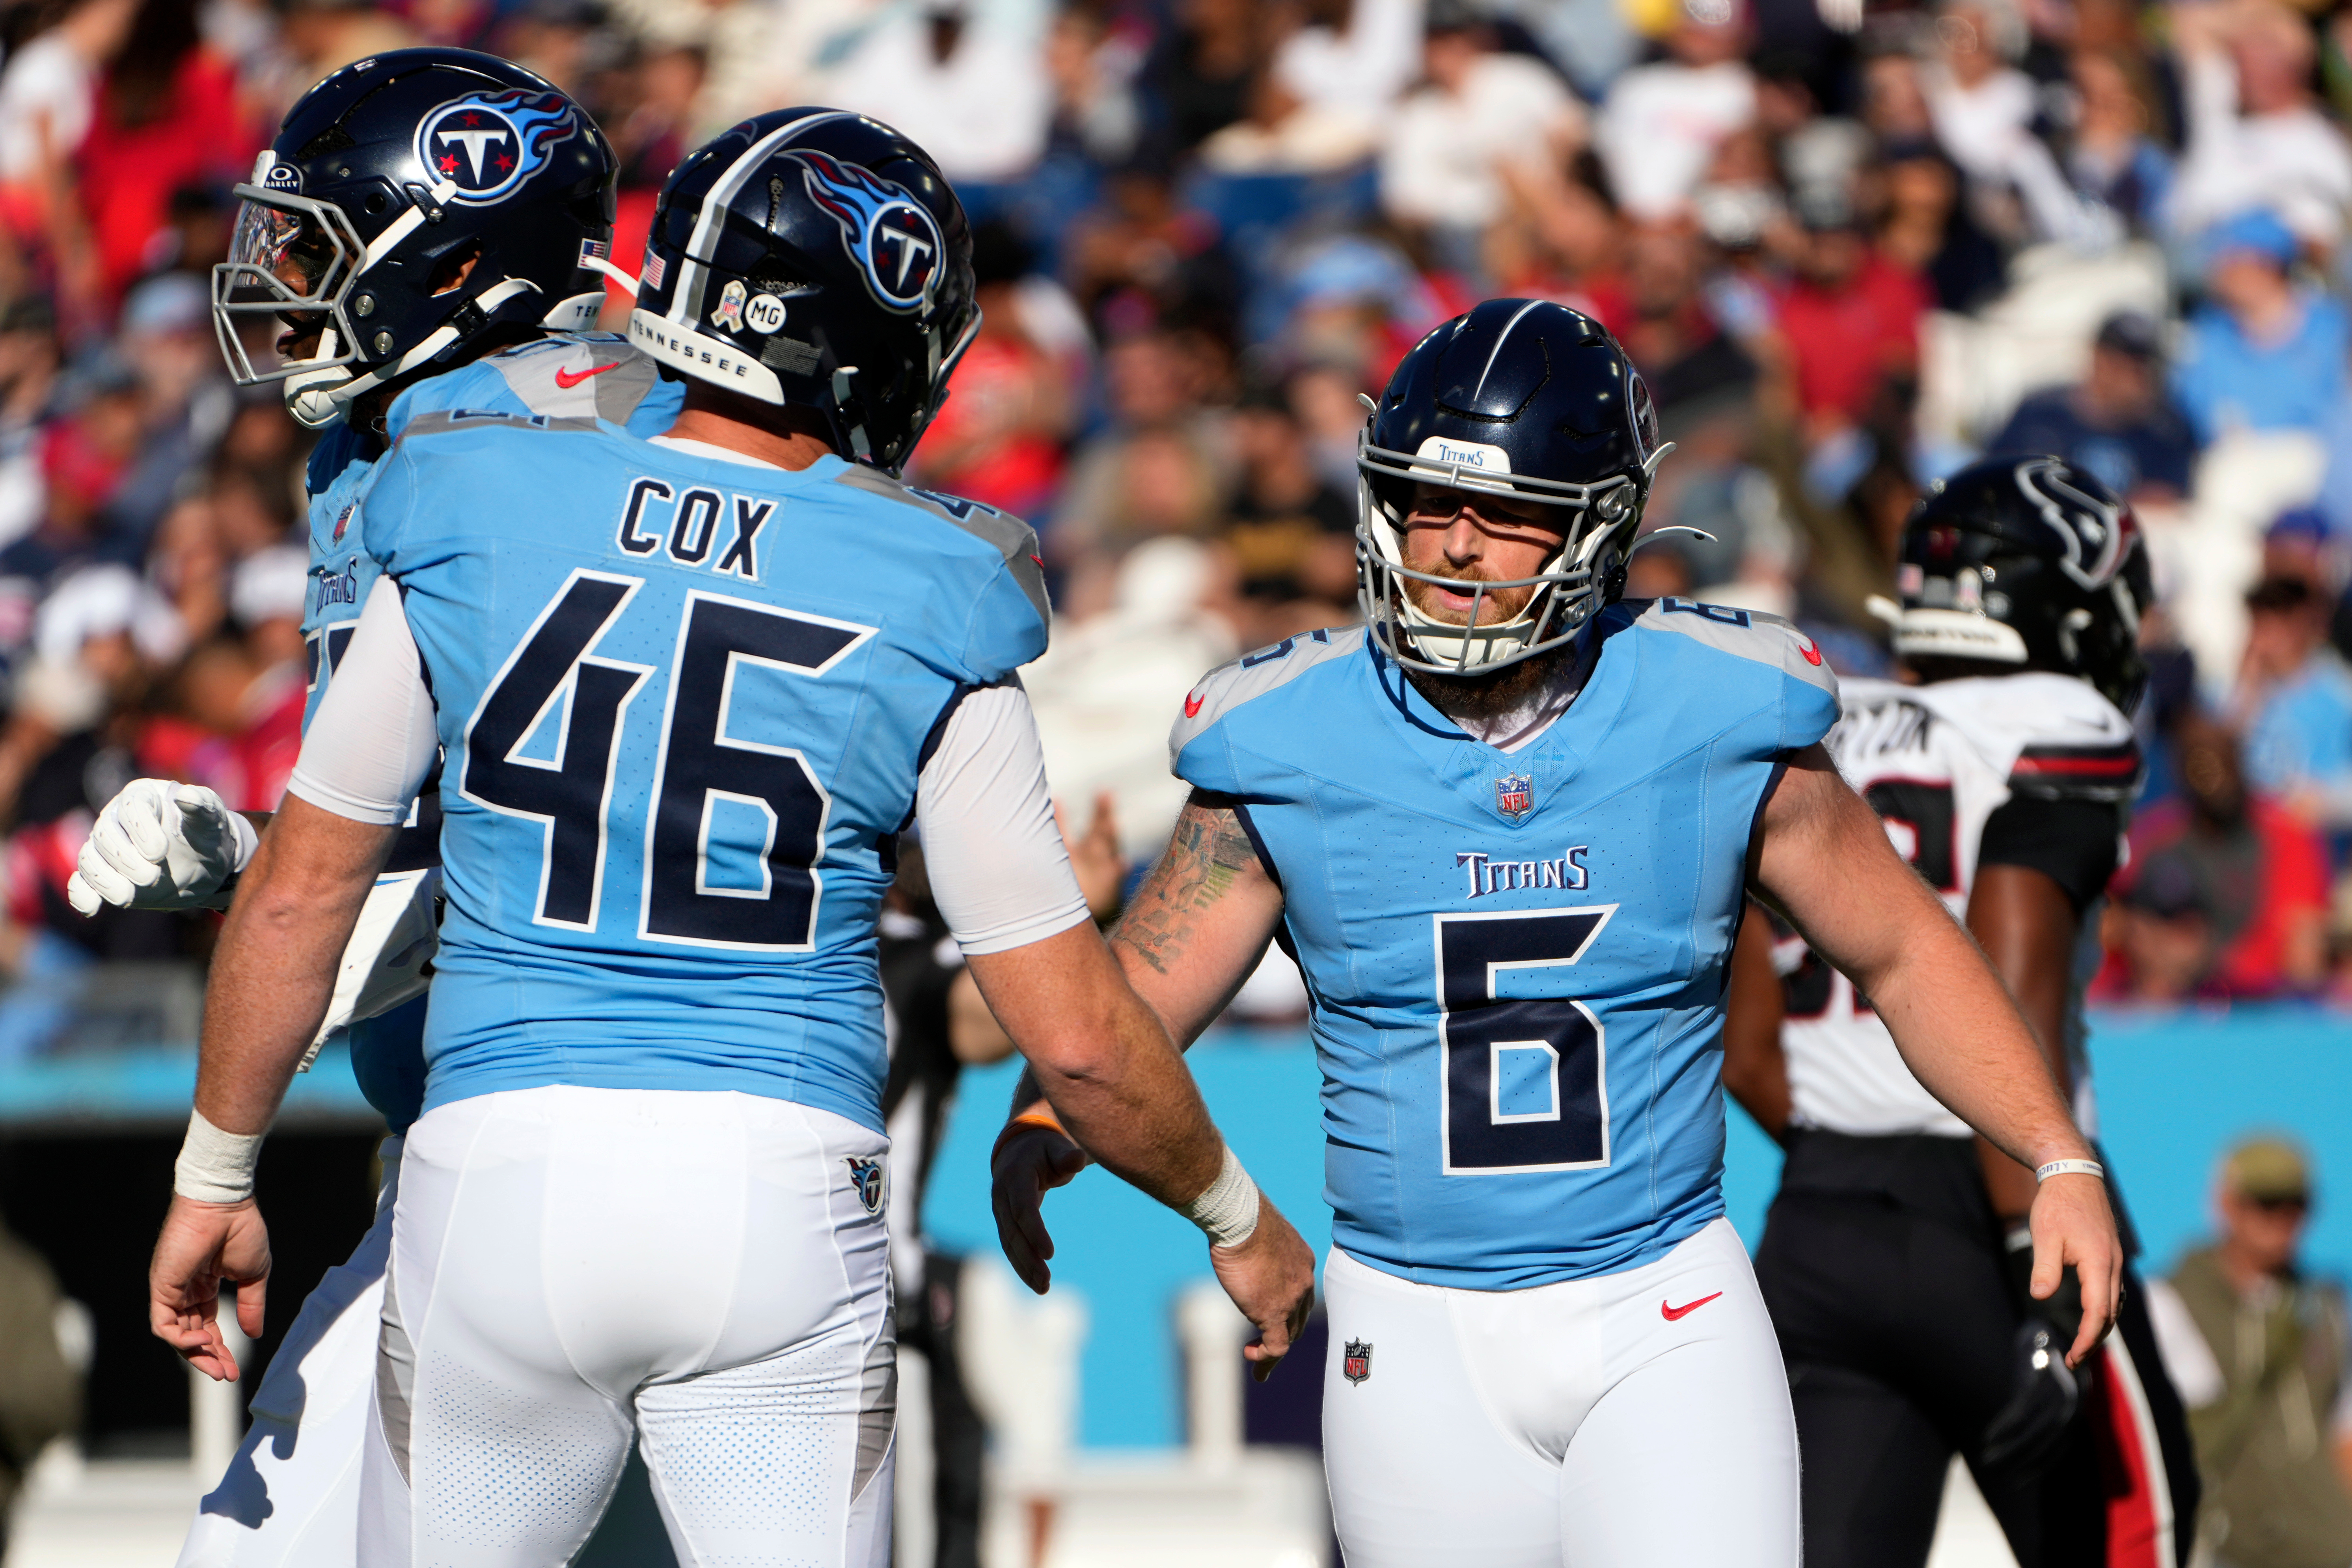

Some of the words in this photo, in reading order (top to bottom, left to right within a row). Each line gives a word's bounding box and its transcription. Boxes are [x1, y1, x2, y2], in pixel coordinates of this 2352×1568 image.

[750, 301, 780, 325] MG
[634, 319, 748, 377] TENNESSEE
[1439, 444, 1484, 466] TITANS
[615, 476, 779, 581] COX
[458, 567, 880, 952] 46
[1502, 793, 1528, 811] NFL
[1456, 845, 1588, 899] TITANS
[1433, 903, 1620, 1176] 6
[1346, 1358, 1367, 1377] NFL
